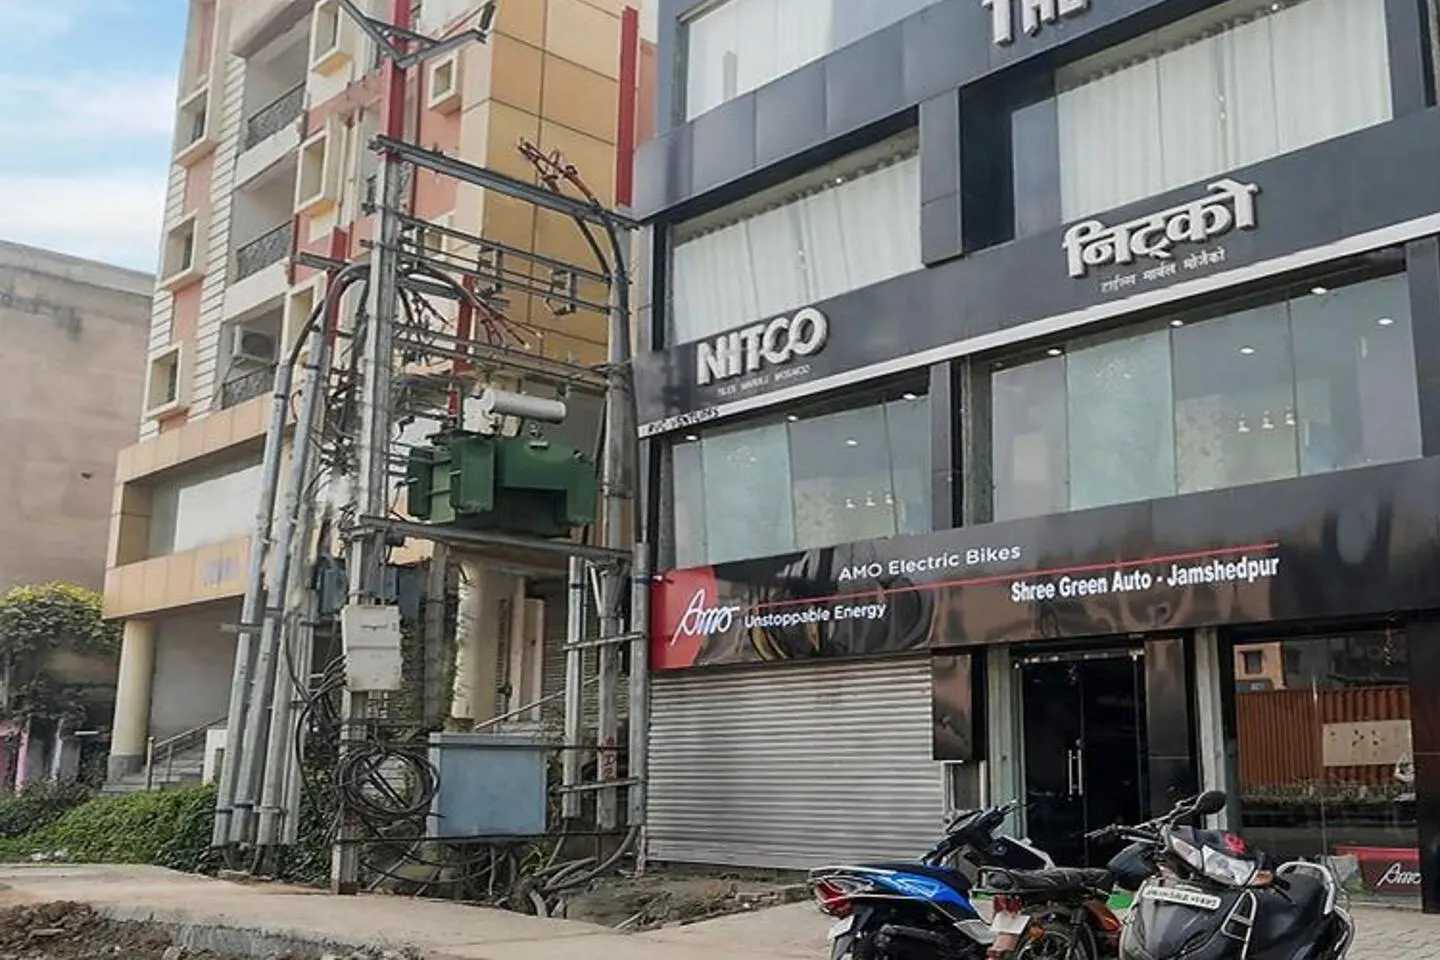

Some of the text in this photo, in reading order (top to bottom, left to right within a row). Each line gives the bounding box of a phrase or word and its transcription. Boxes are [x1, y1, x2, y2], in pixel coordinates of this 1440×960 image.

[696, 307, 828, 386] NITCO
[838, 544, 1021, 582] AMO Electric Bikes
[1011, 581, 1055, 602] Shree
[1058, 576, 1108, 598] Green
[1111, 570, 1151, 593] Auto
[1167, 555, 1280, 587] Jamshedpur
[743, 602, 888, 629] Unstoppable Energy
